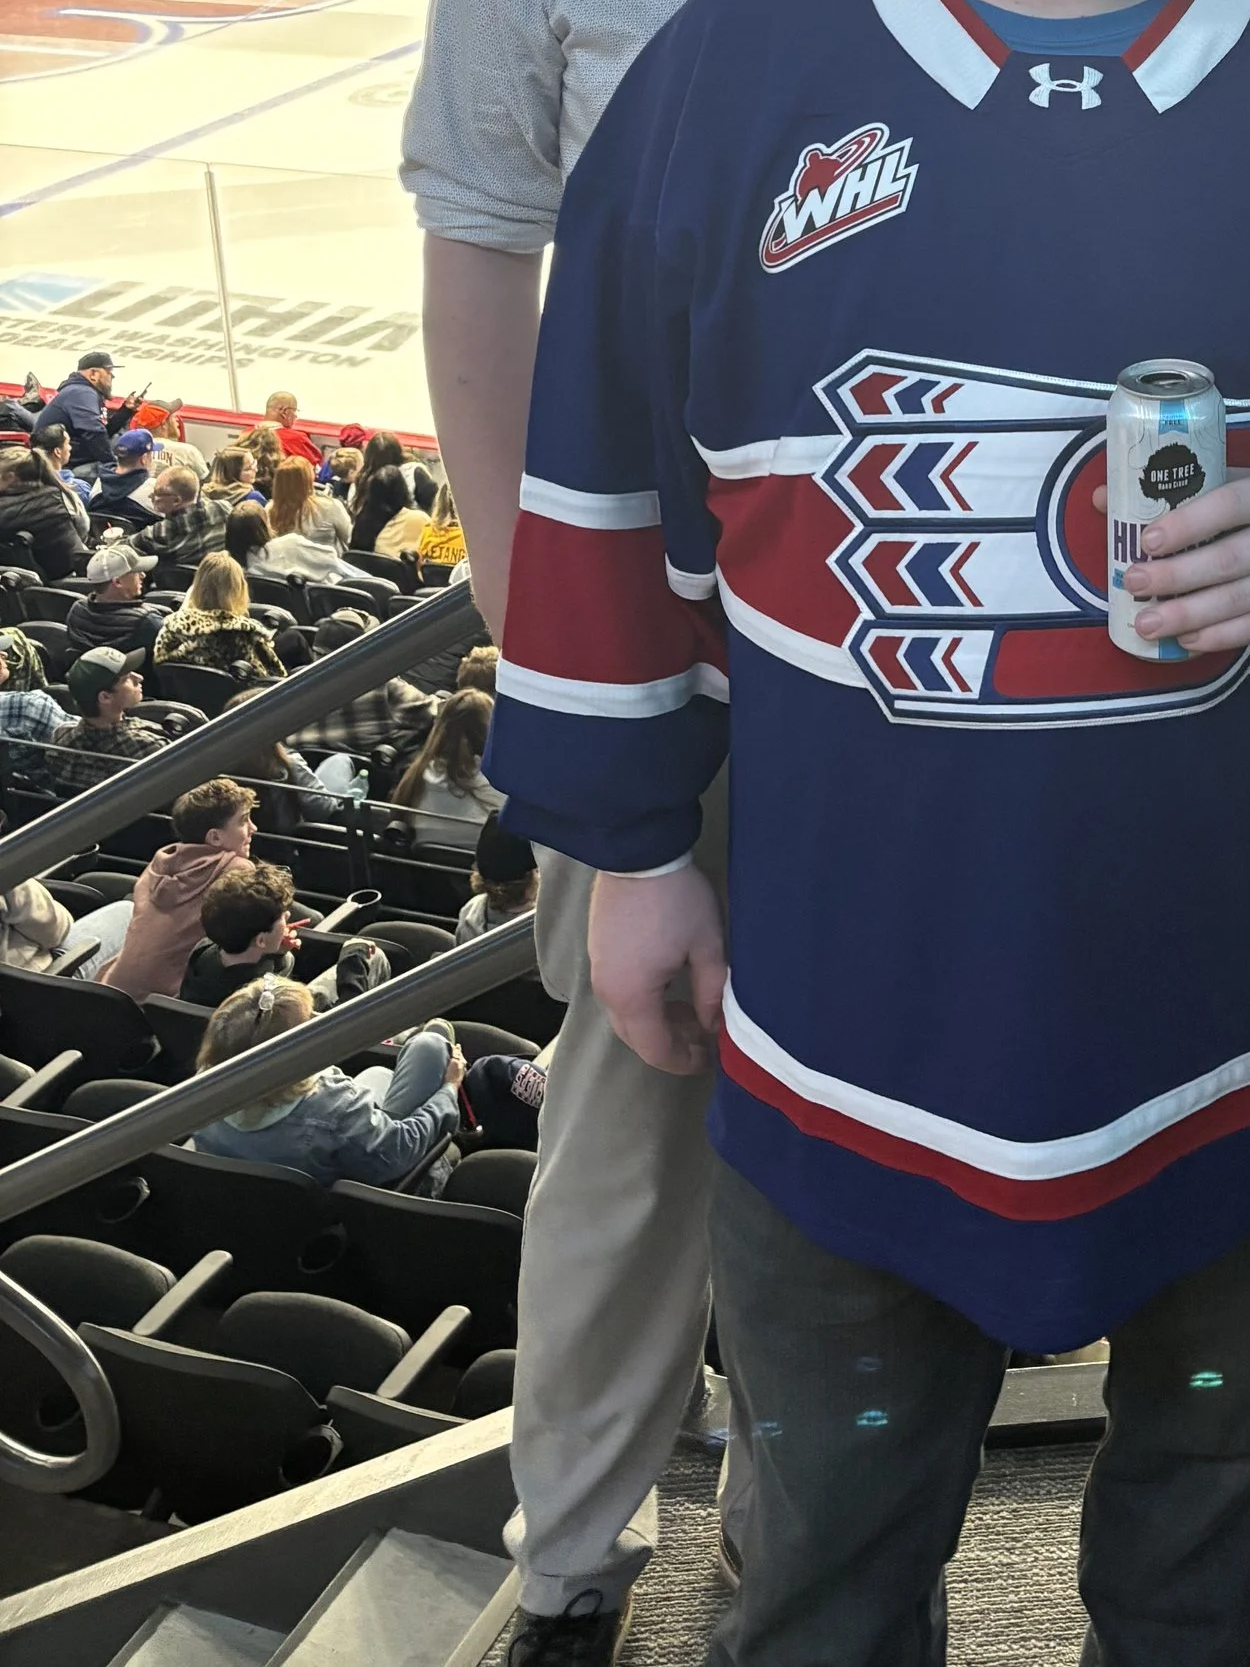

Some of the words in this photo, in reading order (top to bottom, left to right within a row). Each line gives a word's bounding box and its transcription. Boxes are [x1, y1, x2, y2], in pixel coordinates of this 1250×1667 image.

[781, 149, 907, 245] WHL
[48, 280, 420, 352] LITHIA
[1150, 469, 1169, 483] ONE
[1172, 463, 1195, 480] TREE
